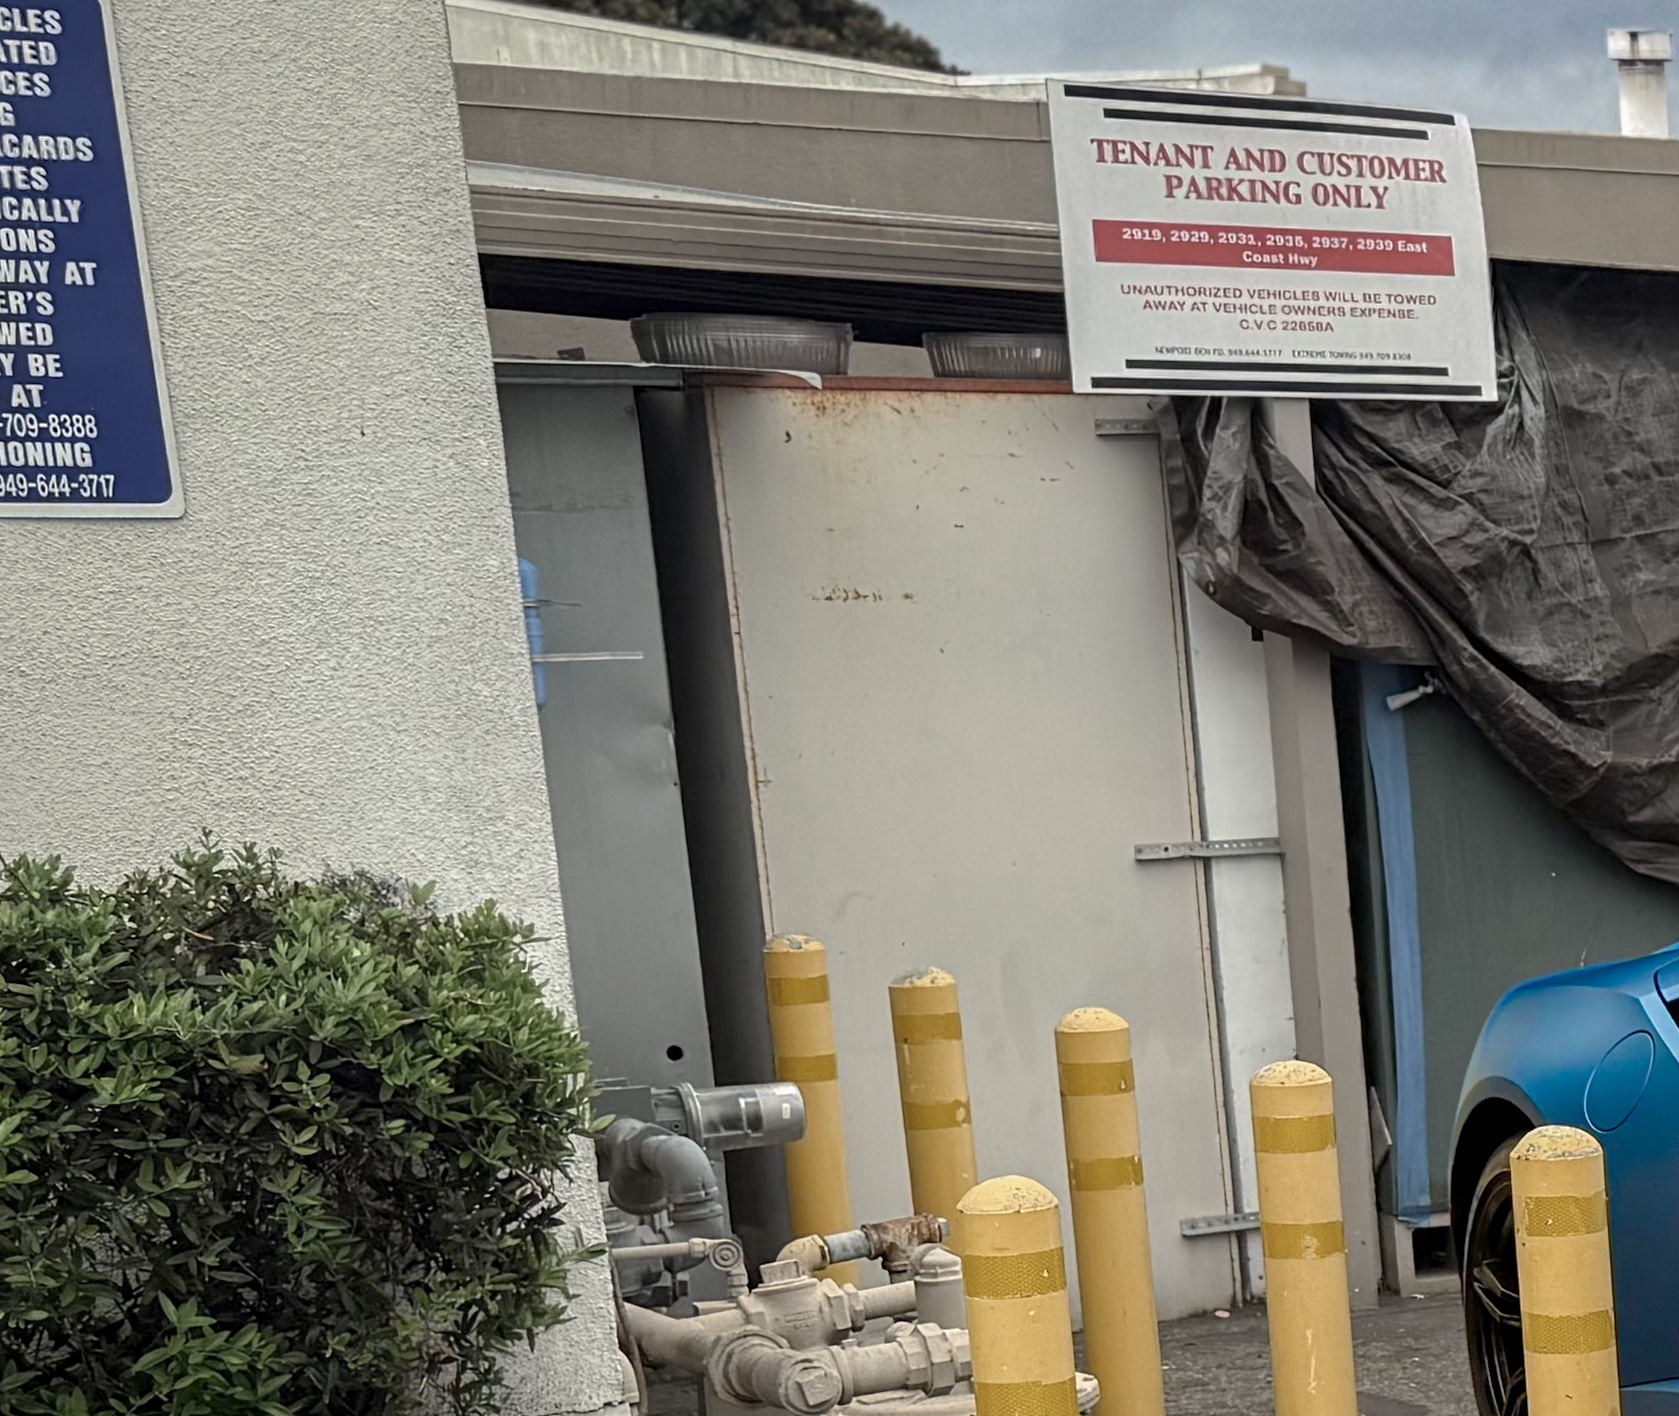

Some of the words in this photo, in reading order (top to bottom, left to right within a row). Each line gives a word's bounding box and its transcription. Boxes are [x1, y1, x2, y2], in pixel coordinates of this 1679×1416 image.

[0, 133, 95, 162] CARDS
[1090, 138, 1215, 170] TENANT
[1224, 146, 1287, 174] AND
[1296, 151, 1447, 184] CUSTOMER
[1163, 174, 1303, 206] PARKING
[1311, 182, 1390, 210] ONLY
[0, 196, 82, 223] CALLY
[1242, 250, 1284, 264] Coast
[1288, 253, 1319, 268] Hwy
[1397, 240, 1428, 254] East
[64, 261, 97, 286] AT
[1120, 284, 1243, 299] UNAUTHORIZED
[1247, 288, 1320, 301] VEHICLES
[1323, 290, 1359, 303] WILL
[1363, 293, 1382, 304] BE
[1385, 293, 1438, 306] TOWED
[1142, 299, 1186, 312] AWAY
[1190, 301, 1209, 313] AT
[1212, 302, 1278, 316] VEHICLE
[1281, 304, 1346, 317] OWNERS
[1350, 306, 1420, 320] EXPENSE.
[1239, 318, 1277, 331] C.V.C
[27, 353, 64, 378] BE
[11, 383, 44, 408] AT
